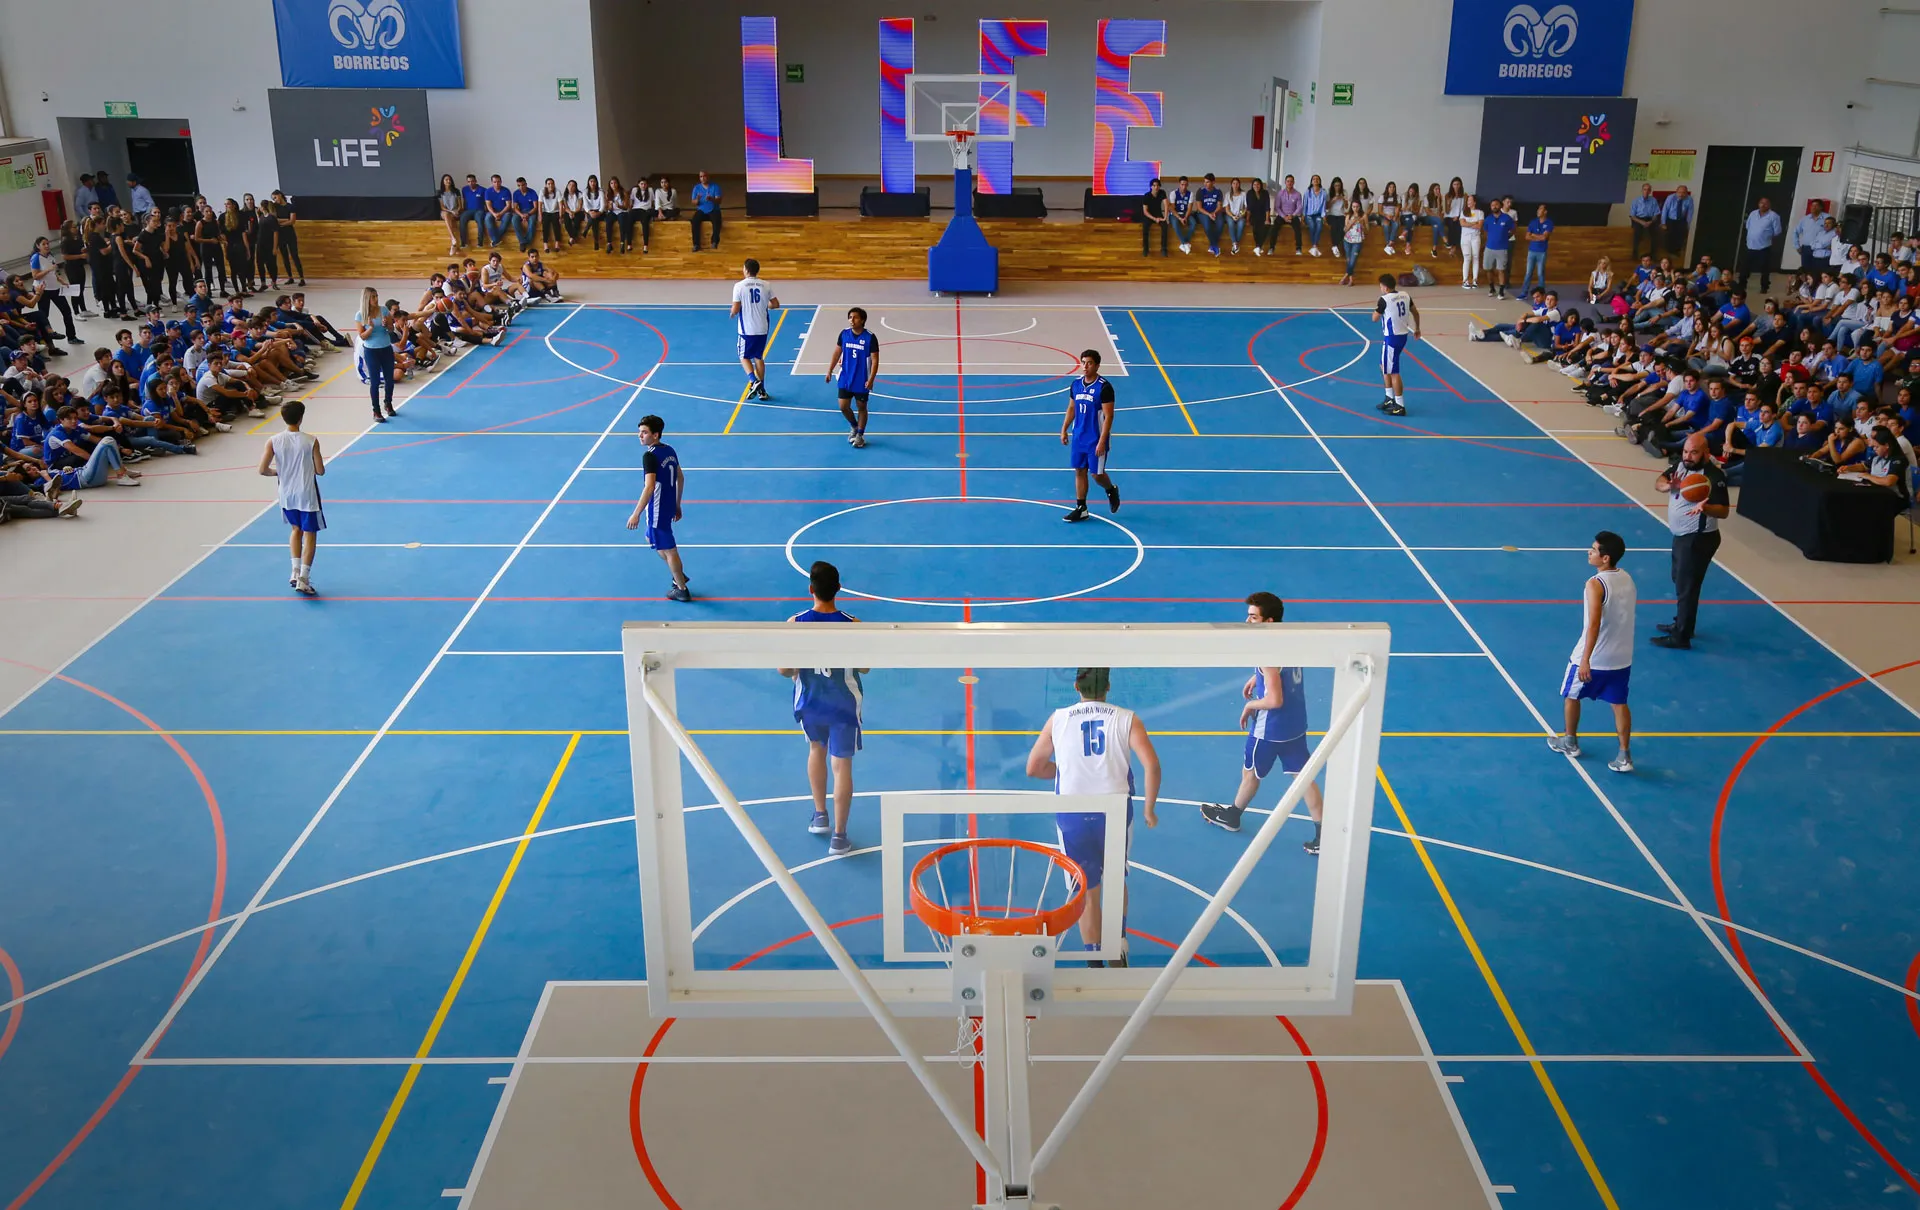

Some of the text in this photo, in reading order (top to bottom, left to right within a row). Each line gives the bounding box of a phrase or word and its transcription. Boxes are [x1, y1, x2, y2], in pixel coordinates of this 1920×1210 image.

[333, 55, 410, 71] BORREGOS
[1498, 63, 1573, 78] BORREGOS
[313, 138, 381, 167] LiFE
[1517, 146, 1582, 175] LiFE
[750, 287, 761, 304] 16
[1396, 300, 1406, 317] 13
[852, 349, 857, 359] 5
[668, 464, 675, 488] 1
[1069, 706, 1116, 717] SONORA NORTE
[1081, 719, 1106, 757] 15
